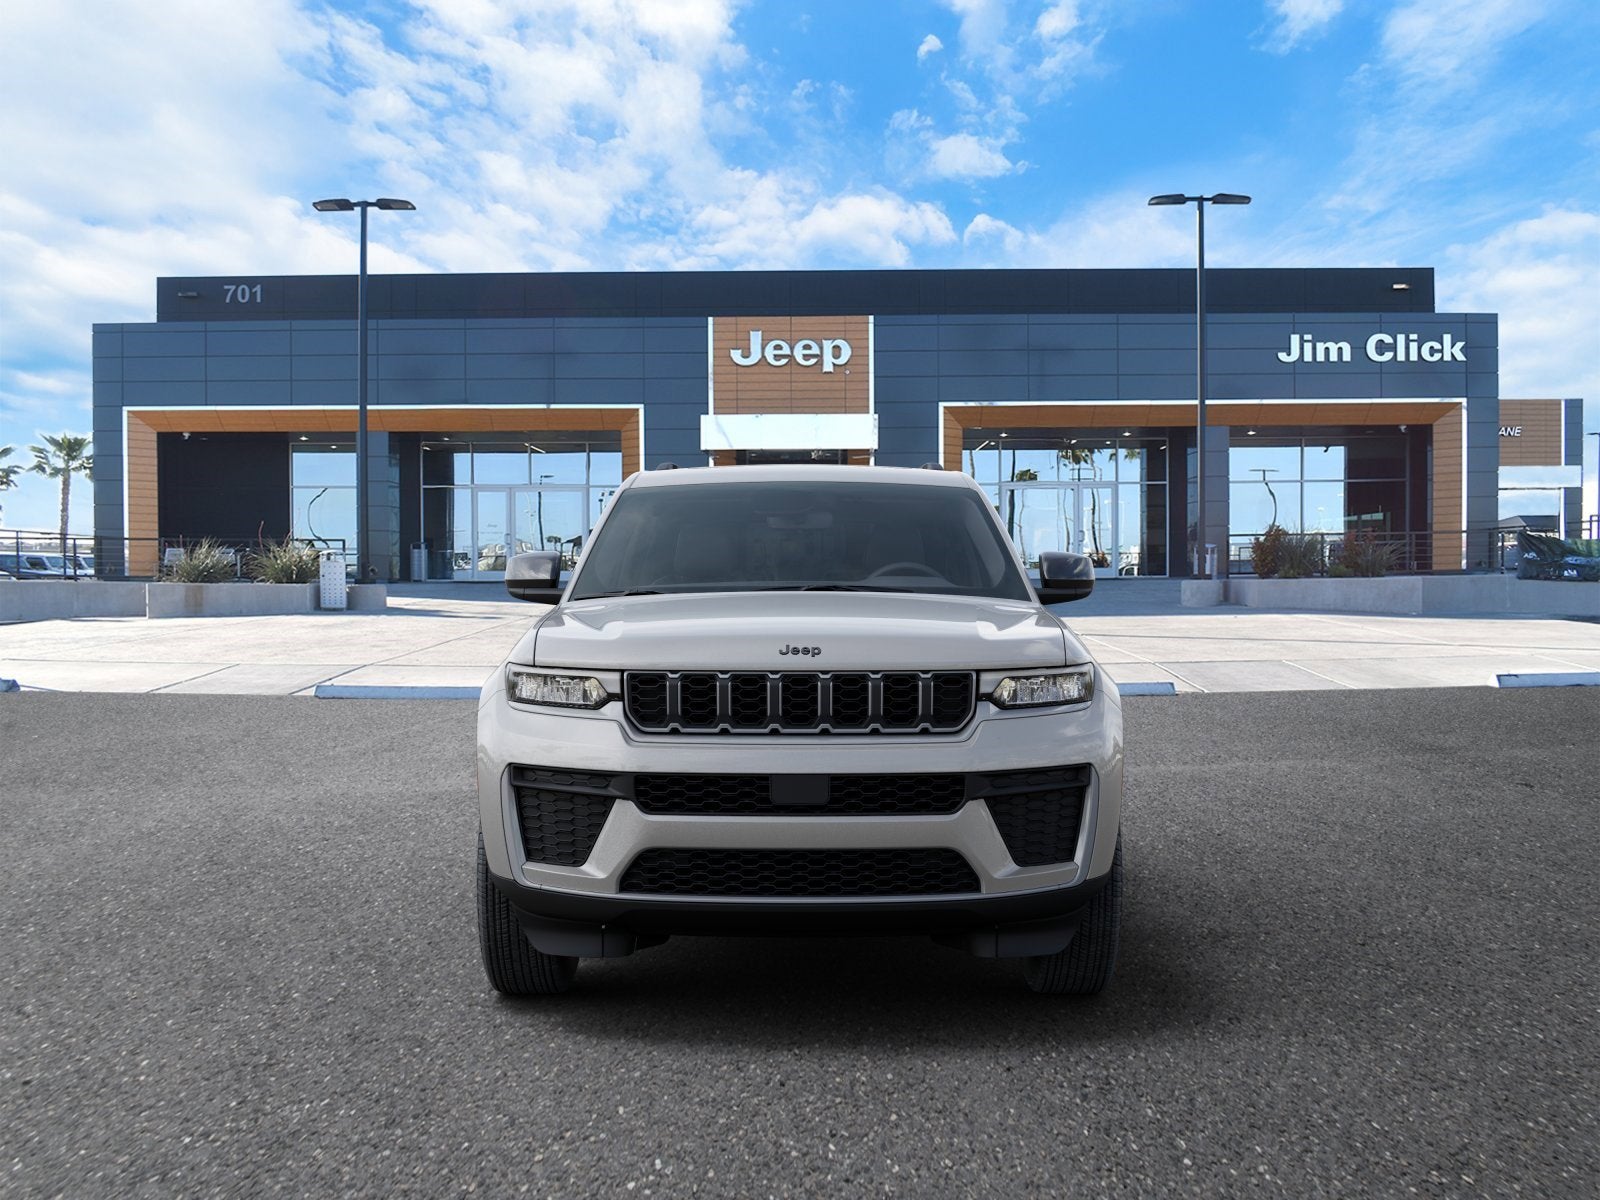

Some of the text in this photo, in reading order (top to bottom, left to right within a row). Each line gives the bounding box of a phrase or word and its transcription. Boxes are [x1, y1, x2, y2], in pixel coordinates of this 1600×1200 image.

[223, 284, 262, 304] 701
[729, 329, 853, 374] Jeep
[1277, 332, 1467, 363] Jim Click
[779, 644, 822, 658] Jeep
